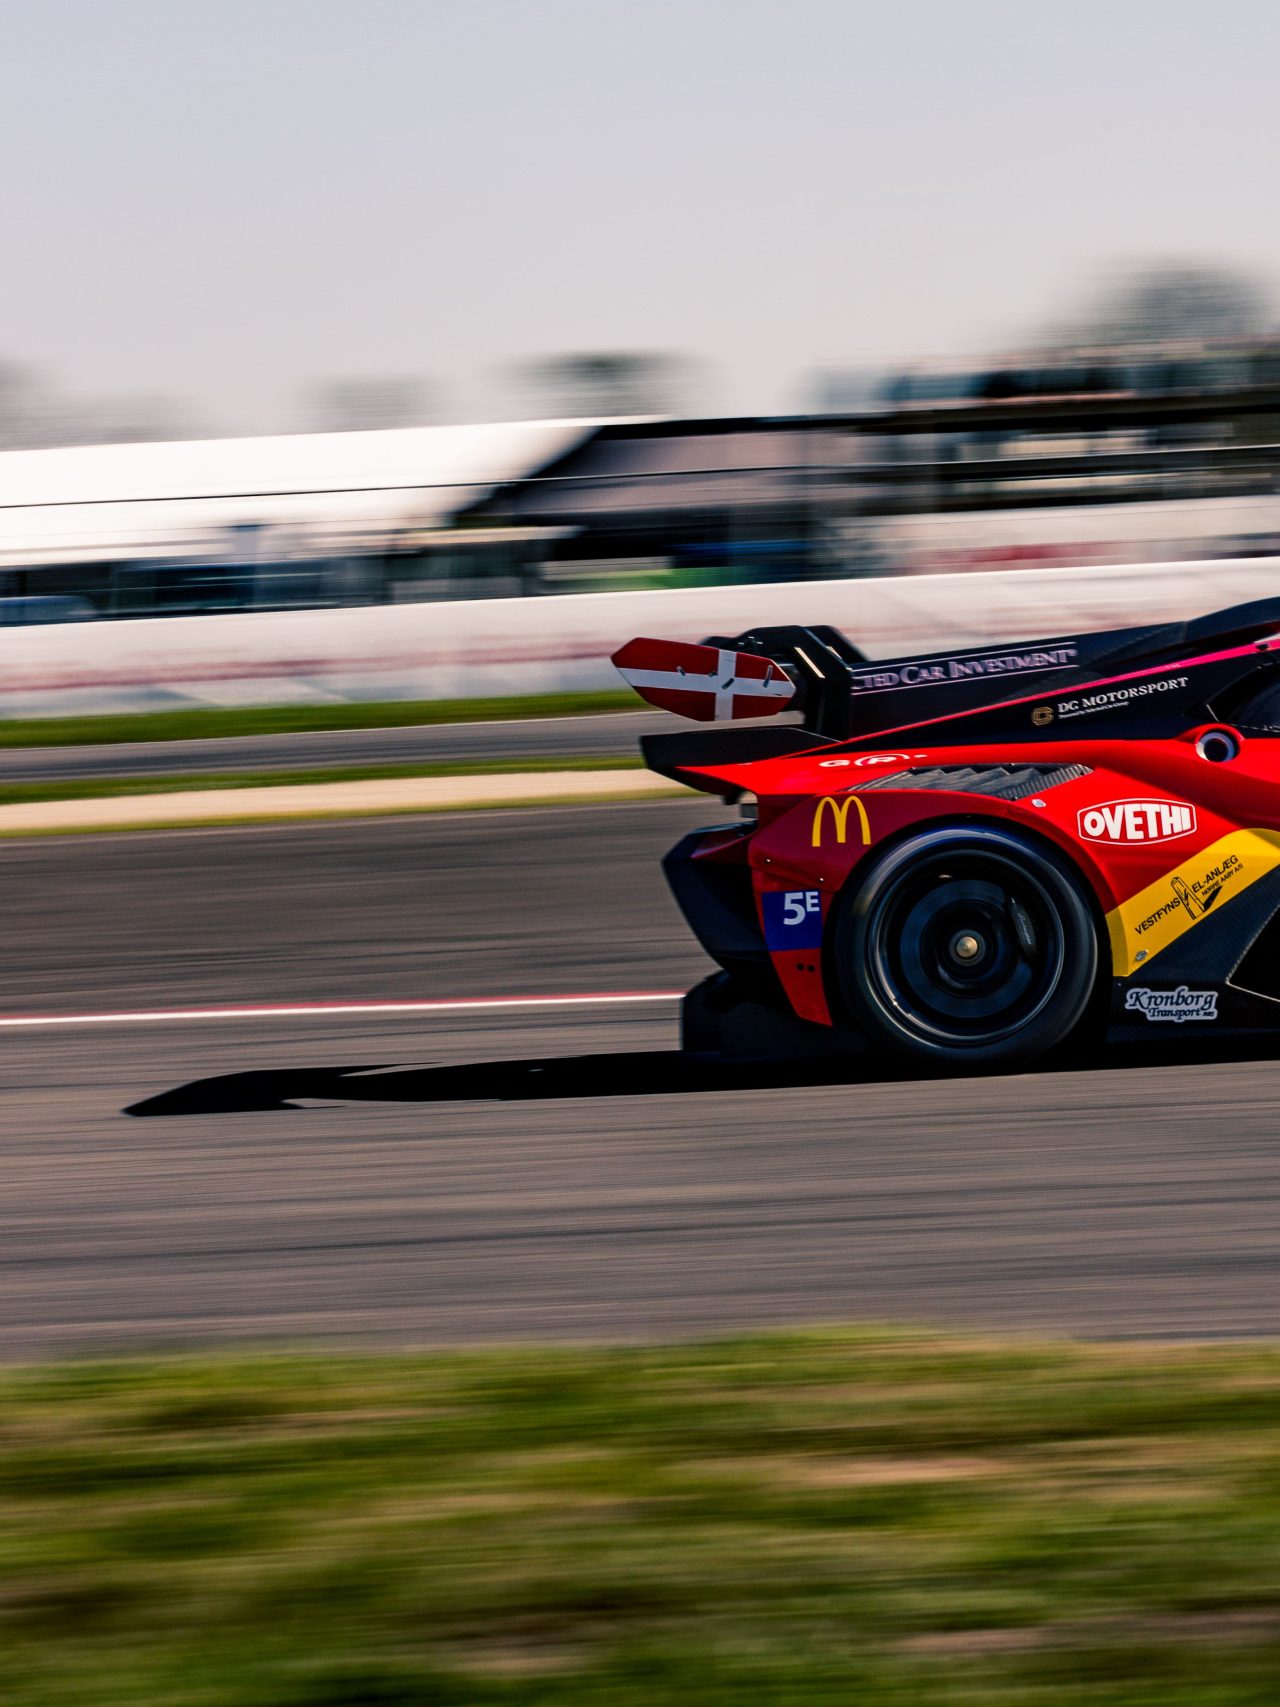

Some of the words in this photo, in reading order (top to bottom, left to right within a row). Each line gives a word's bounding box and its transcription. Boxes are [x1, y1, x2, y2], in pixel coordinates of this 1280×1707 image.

[1081, 676, 1189, 708] MOTORSPORT
[1084, 803, 1191, 840] OVETHI
[1134, 897, 1181, 935] VESTFYNS
[1129, 988, 1215, 1011] Kronborg
[1148, 1007, 1200, 1019] Transport
